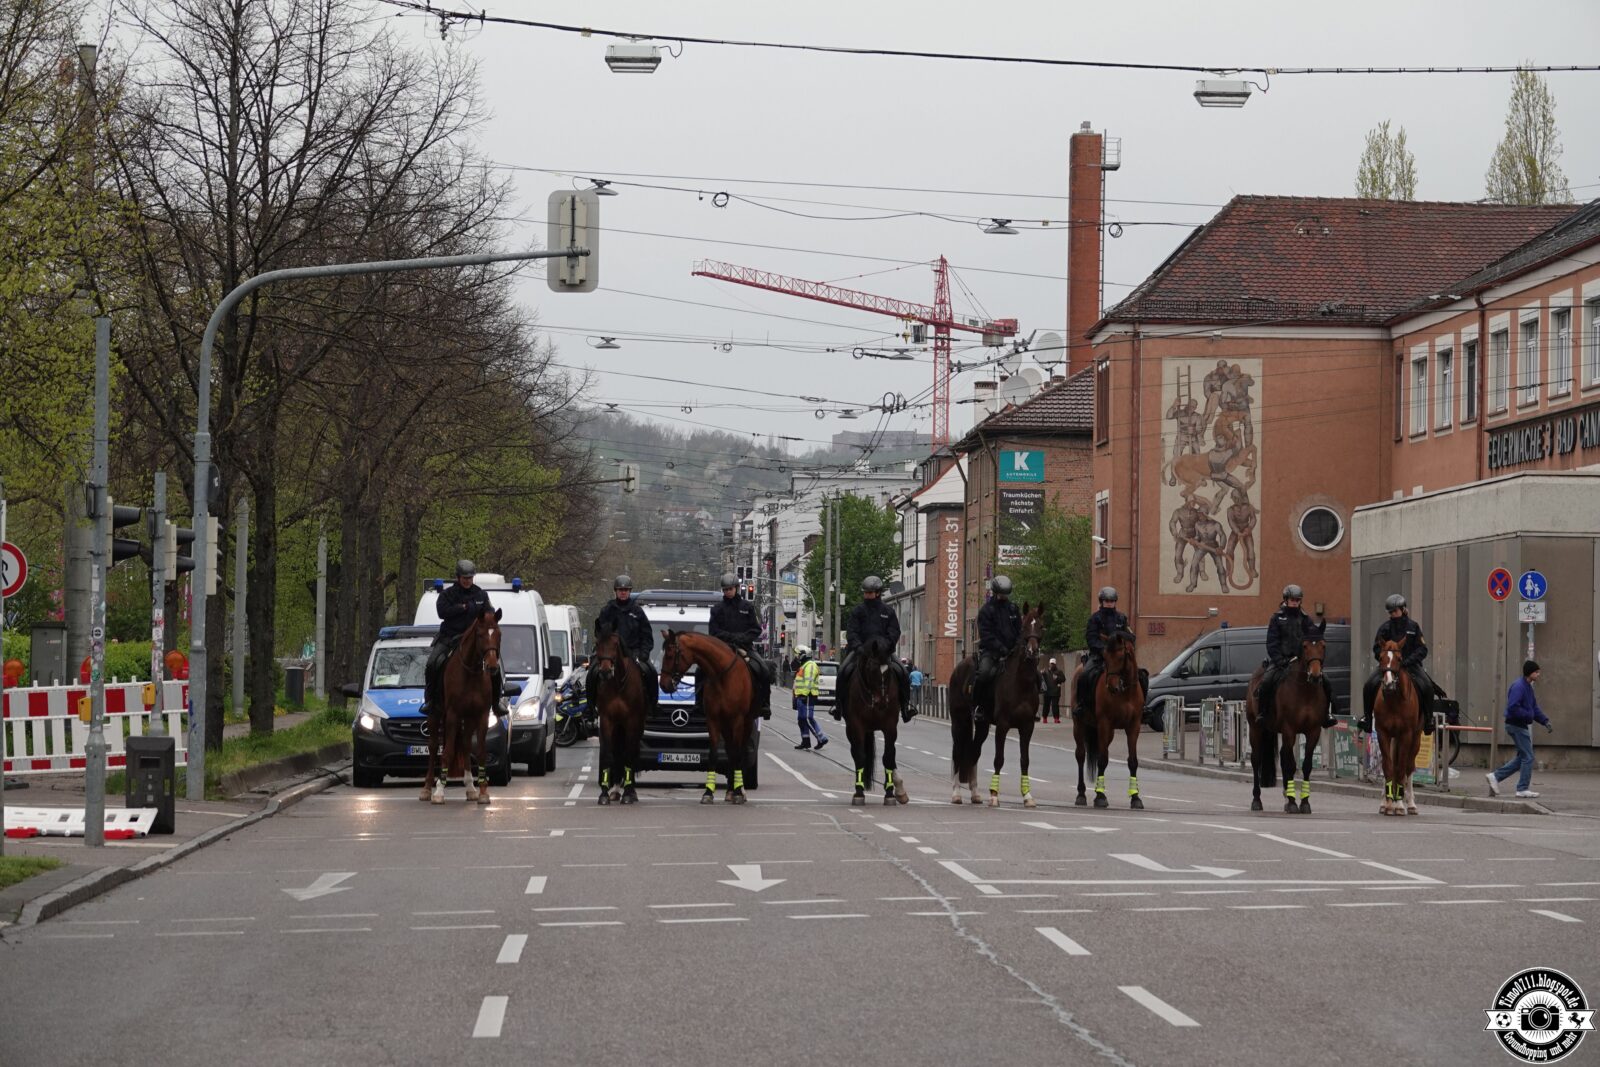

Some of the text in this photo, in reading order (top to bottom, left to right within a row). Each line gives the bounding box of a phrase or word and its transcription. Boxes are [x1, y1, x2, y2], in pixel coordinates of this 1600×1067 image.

[1488, 424, 1544, 469] FEUERWACHE
[1545, 421, 1553, 456] 3
[1557, 416, 1576, 454] BAD
[1014, 451, 1030, 471] K
[1002, 491, 1042, 499] Traumküchen
[944, 517, 959, 637] Mercedesstr. 31
[662, 754, 674, 762] BWL
